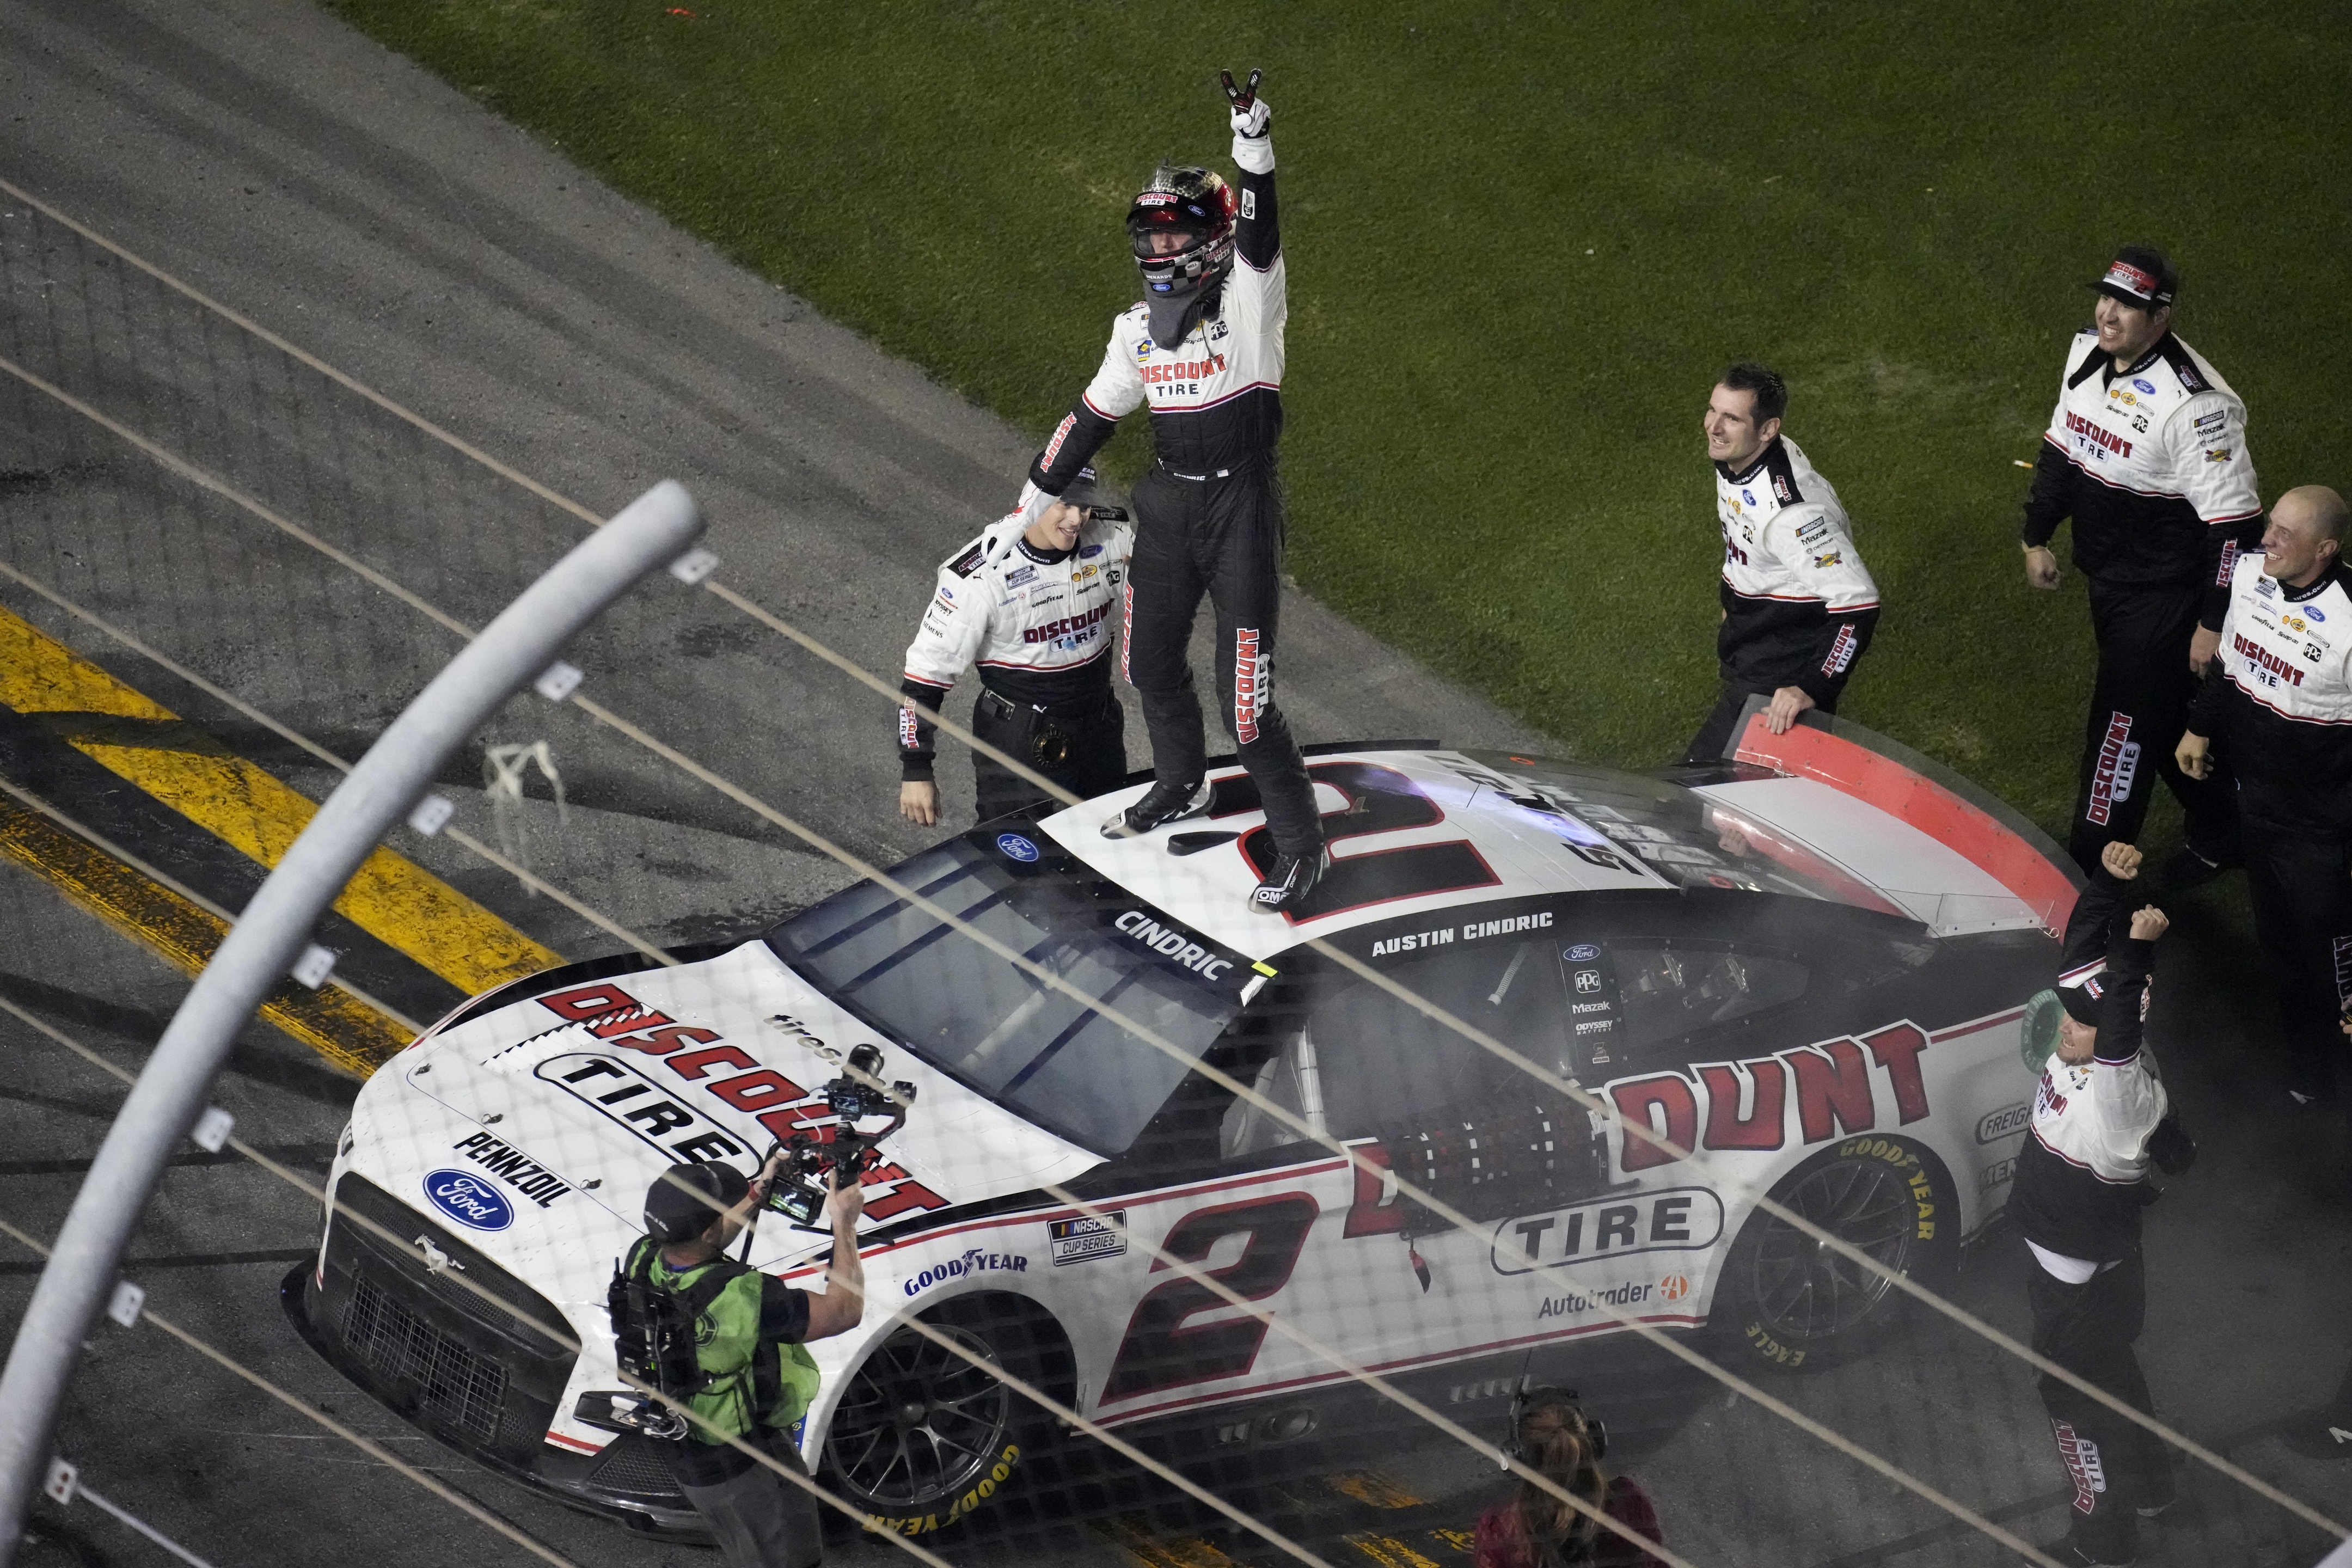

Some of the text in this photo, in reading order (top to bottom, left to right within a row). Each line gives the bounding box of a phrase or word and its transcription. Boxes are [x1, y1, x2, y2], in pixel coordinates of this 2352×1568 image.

[1136, 193, 1178, 203] DISCOUNT
[1211, 324, 1228, 340] PPG
[1140, 353, 1227, 384] DISCOUNT
[1155, 383, 1199, 397] TIRE
[2133, 416, 2148, 432] PPG
[2202, 411, 2224, 424] NASCAR
[2066, 410, 2133, 458] DISCOUNT
[2197, 423, 2226, 438] Mazak
[2078, 436, 2105, 460] TRE
[1801, 528, 1829, 546] Mazak
[1802, 517, 1824, 534] NASCAR
[1014, 567, 1031, 578] NASCAR
[1020, 573, 1034, 582] SERIES
[1032, 595, 1064, 608] GOODYEAR
[923, 621, 944, 638] SIEMENS
[2252, 614, 2275, 631] GOODYEAR
[2277, 631, 2299, 645] Snap-on
[1837, 642, 1854, 667] TIRE
[2234, 632, 2305, 687] DISCOUNT
[2305, 645, 2320, 661] PPG
[1235, 628, 1260, 744] DISCOUNT
[2249, 661, 2277, 688] TRE
[904, 696, 919, 749] DISCOUN
[2086, 711, 2133, 826] DISCOUNT
[2115, 746, 2137, 794] TIRE
[1114, 910, 1234, 981] CINDRIC
[1371, 911, 1553, 957] AUSTIN CINDRIC
[1577, 973, 1599, 990] PPG
[2091, 978, 2104, 994] TEAM
[1572, 1001, 1611, 1014] Mazak
[1576, 1020, 1613, 1032] ODYSSEY
[1577, 1027, 1612, 1035] BATTERY
[763, 1014, 842, 1066] tires.
[561, 1058, 743, 1163] TIRE
[452, 1131, 571, 1209] PENNZOIL
[436, 1178, 500, 1220] Ford
[1840, 1137, 1935, 1240] GOODYEAR
[1073, 1215, 1113, 1235] NASCAR
[1515, 1197, 1692, 1261] TIRE
[1062, 1234, 1116, 1254] CUP SERIES
[904, 1248, 1028, 1297] GOODYEAR
[1098, 1190, 1320, 1407] 2
[1538, 1281, 1653, 1319] Autotrader
[1745, 1321, 1805, 1367] EAGLE
[2082, 1443, 2102, 1485] TIRE
